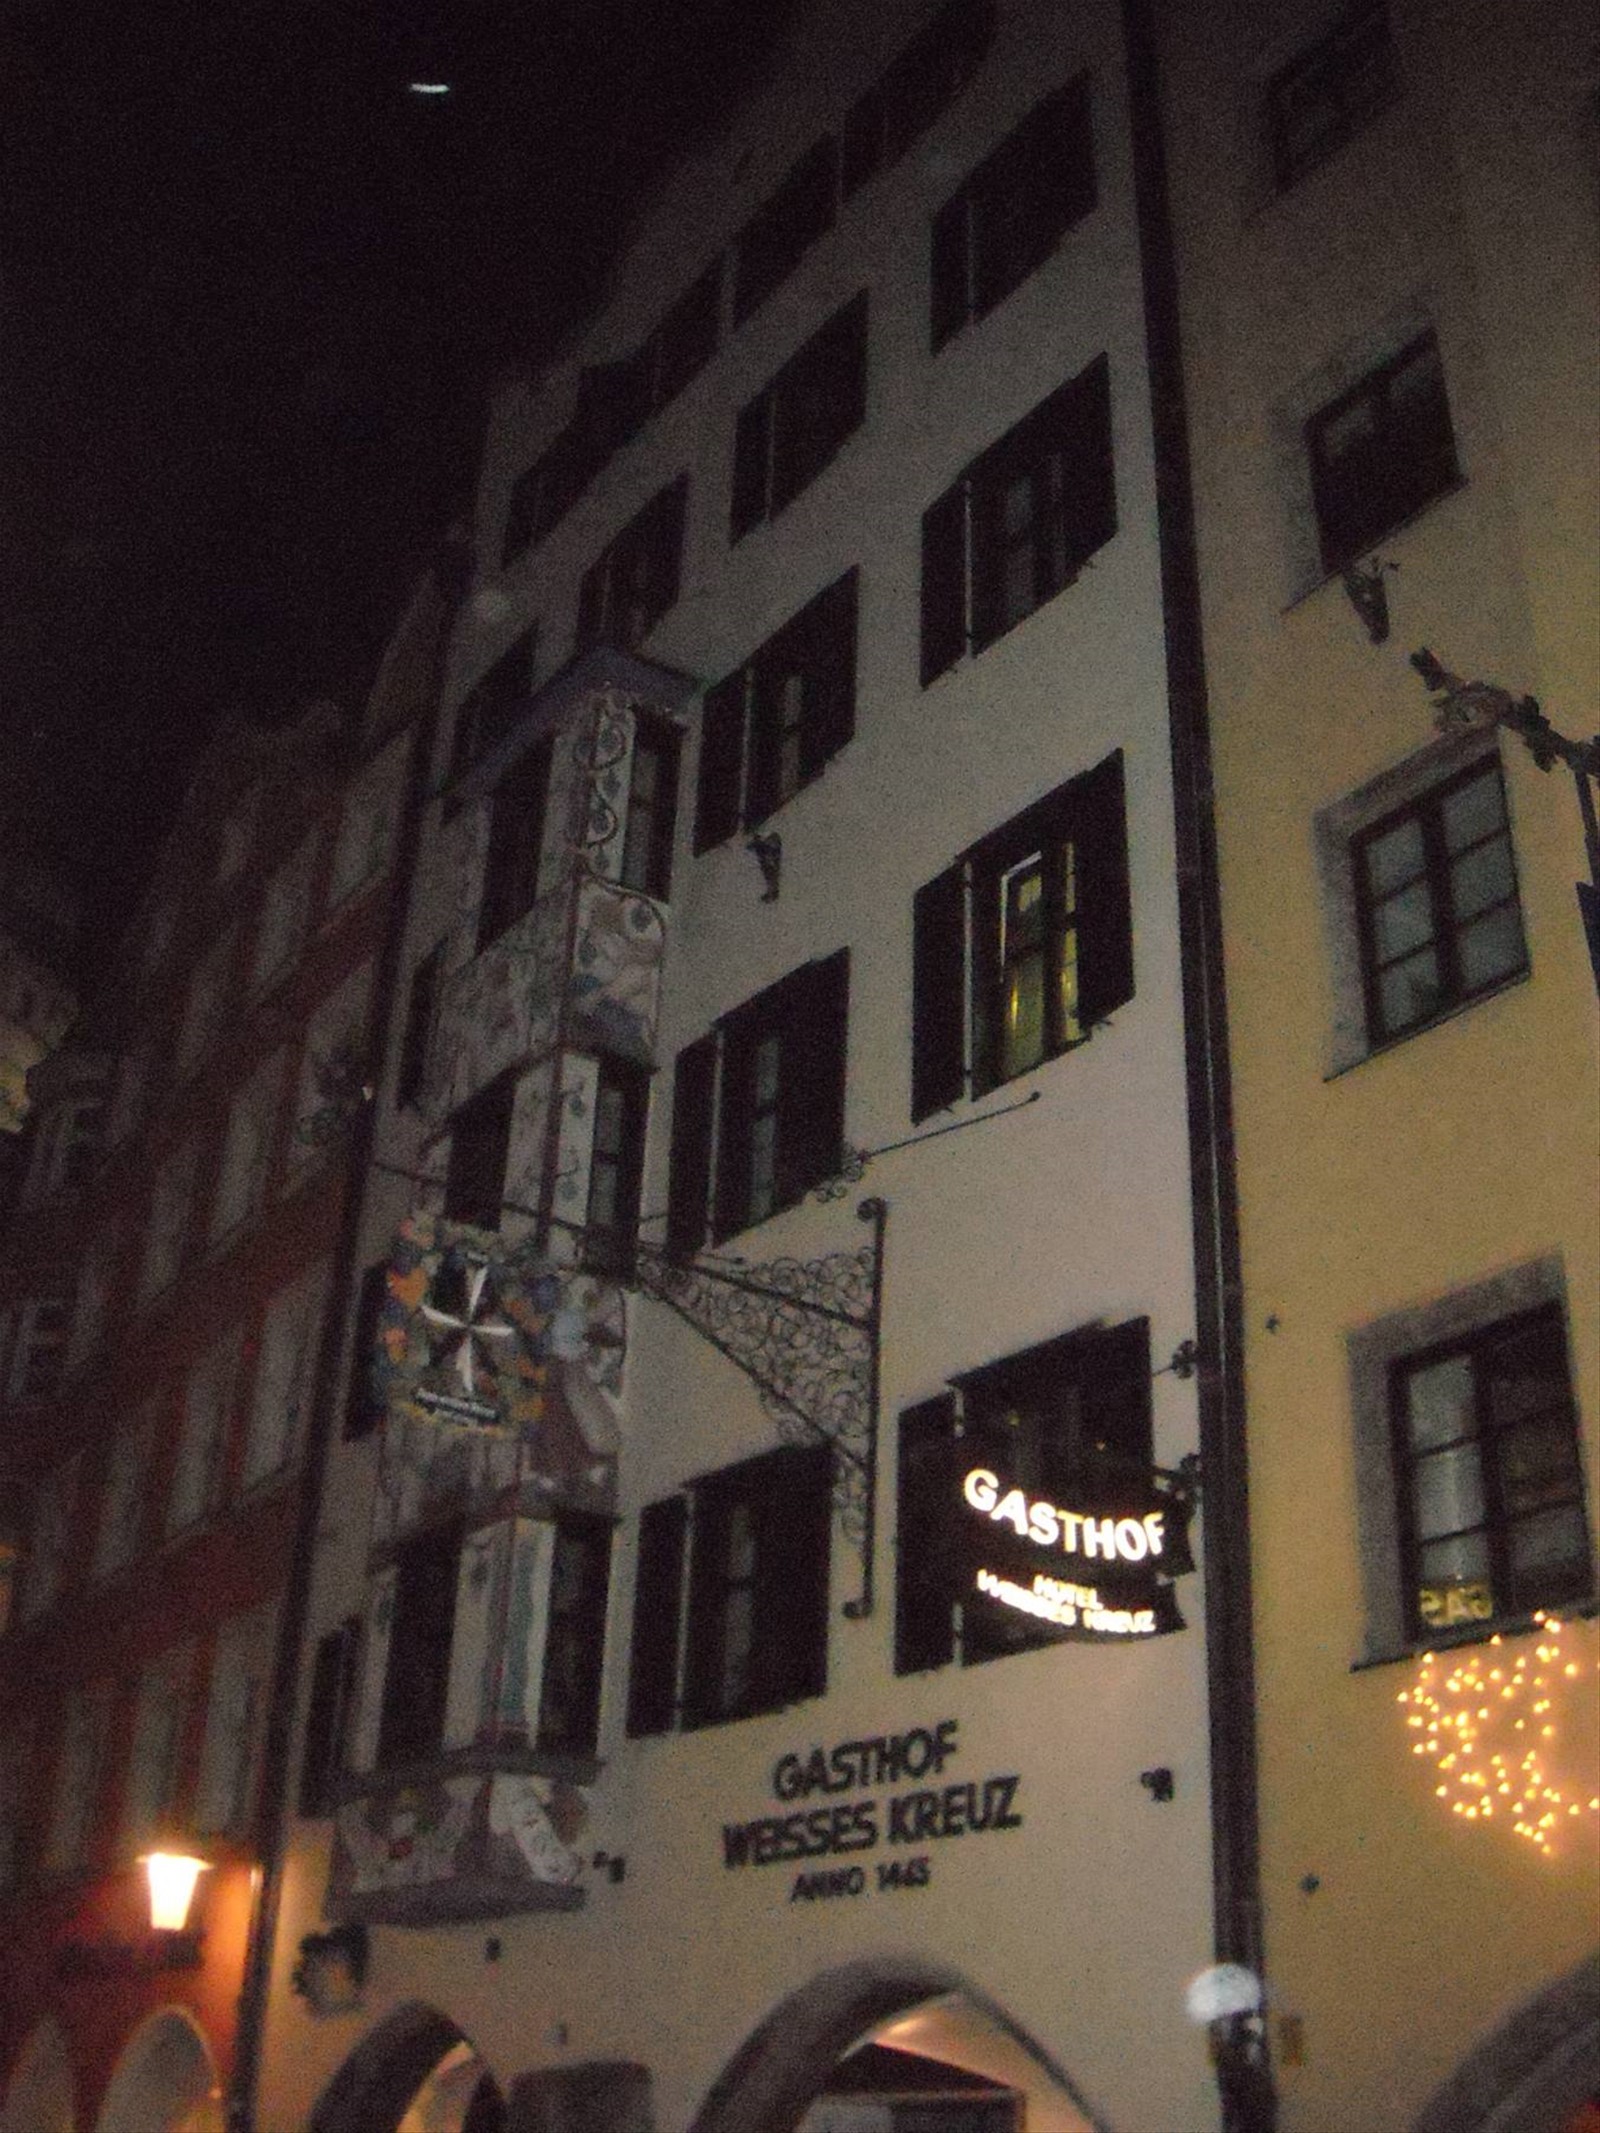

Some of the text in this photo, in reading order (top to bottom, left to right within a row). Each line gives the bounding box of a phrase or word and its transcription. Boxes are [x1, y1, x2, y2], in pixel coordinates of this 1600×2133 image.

[963, 1468, 1164, 1561] GASTHOF
[1083, 1609, 1156, 1633] KUZ
[772, 1718, 958, 1800] GASTHOF
[888, 1775, 1022, 1844] KREUZ
[790, 1866, 866, 1902] ANNO
